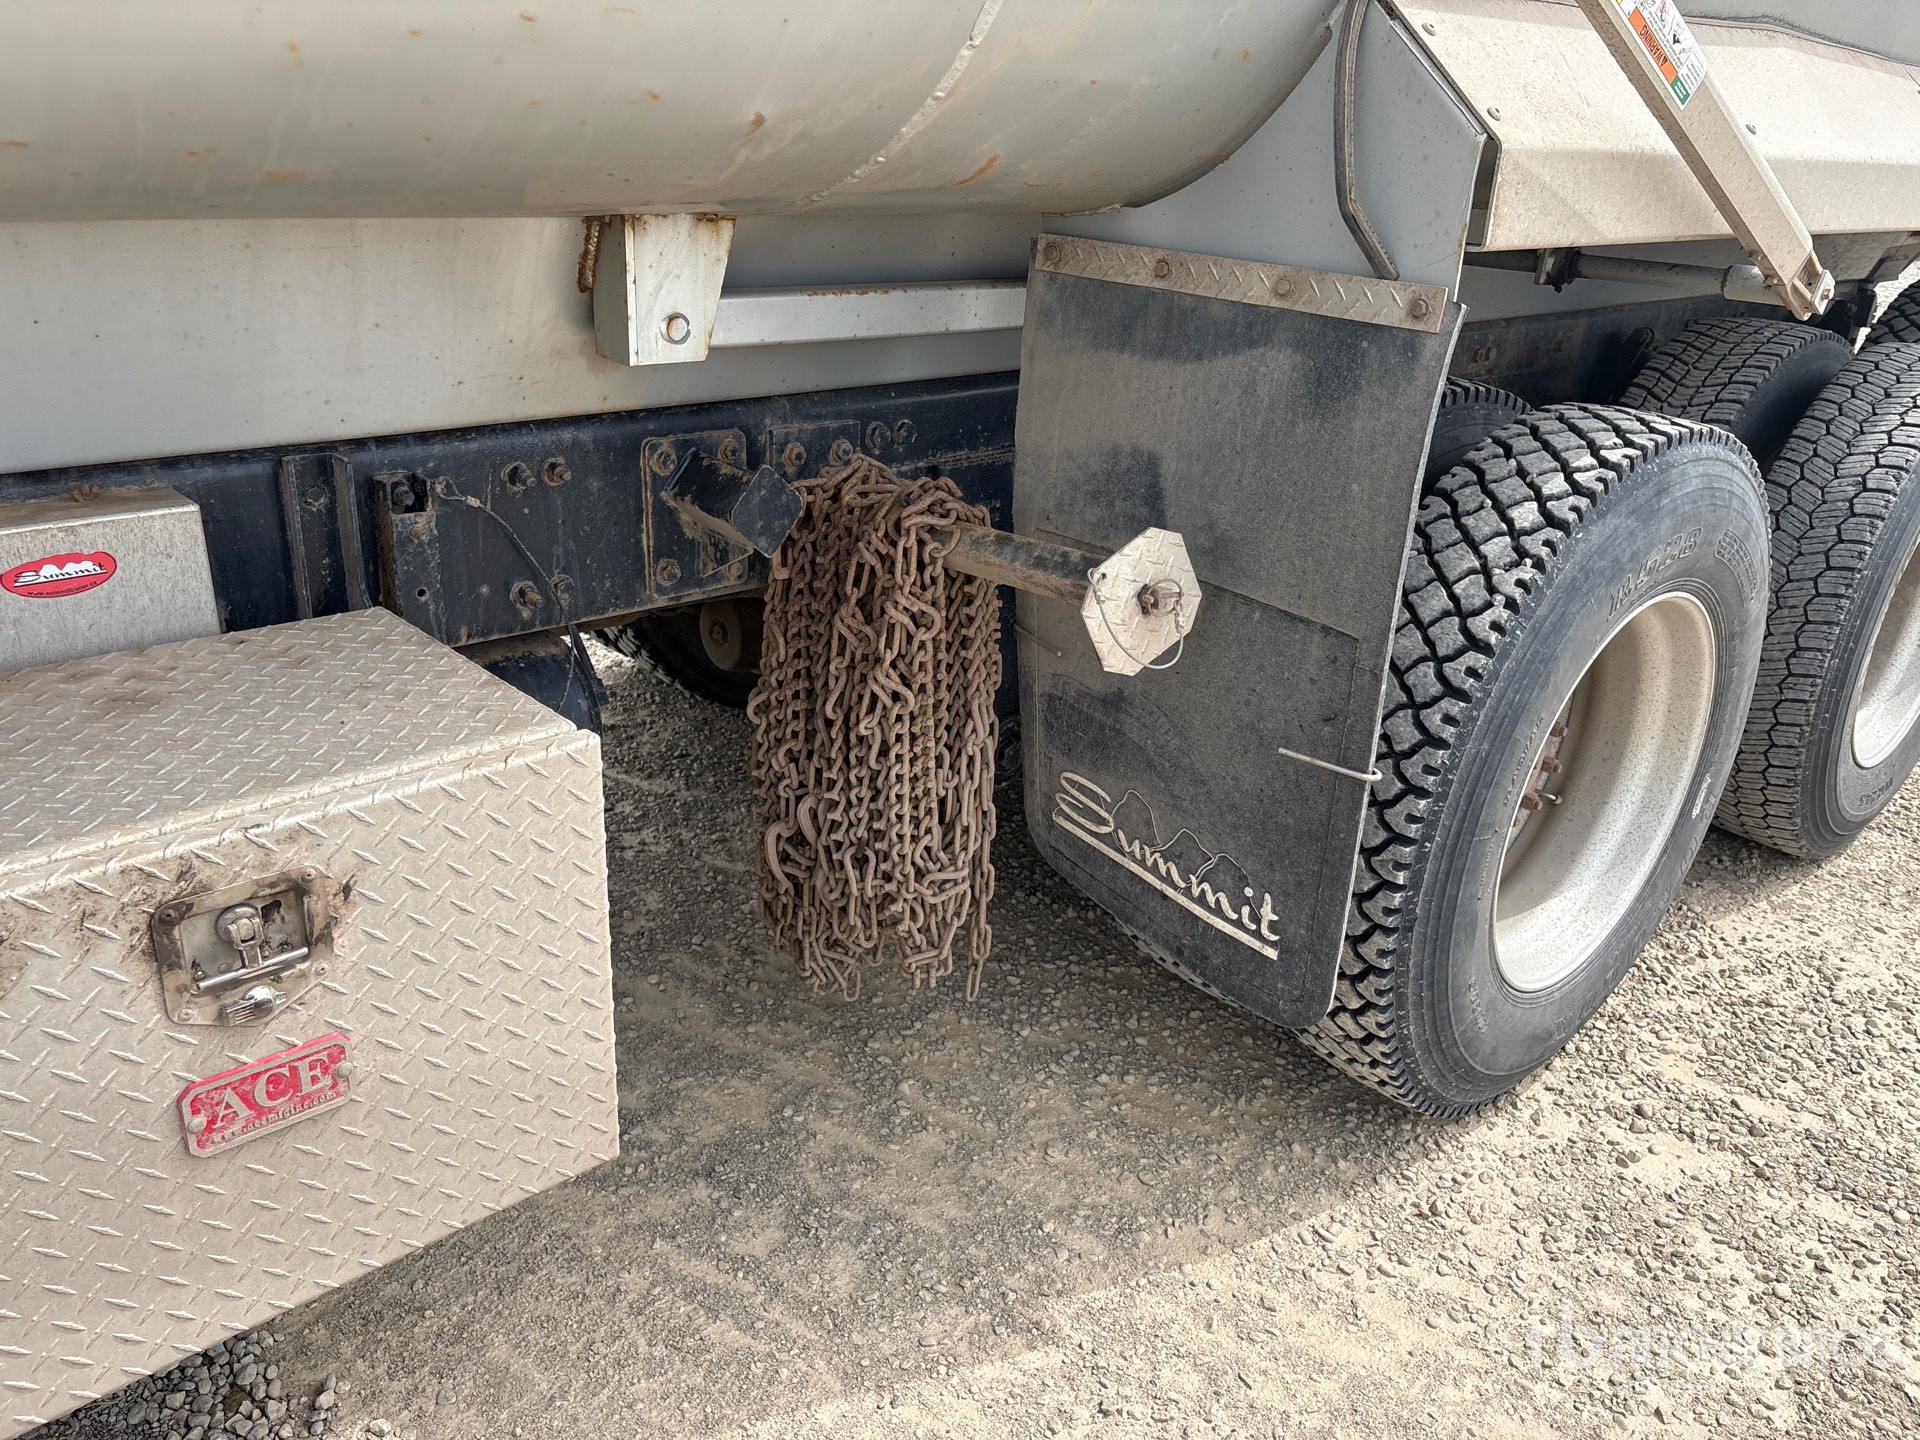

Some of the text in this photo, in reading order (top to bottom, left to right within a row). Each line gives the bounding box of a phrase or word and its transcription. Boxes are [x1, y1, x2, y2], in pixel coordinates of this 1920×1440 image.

[1640, 25, 1664, 66] WARNING
[14, 561, 105, 584] Summit
[1055, 771, 1281, 941] Summit
[213, 1052, 333, 1129] ACE
